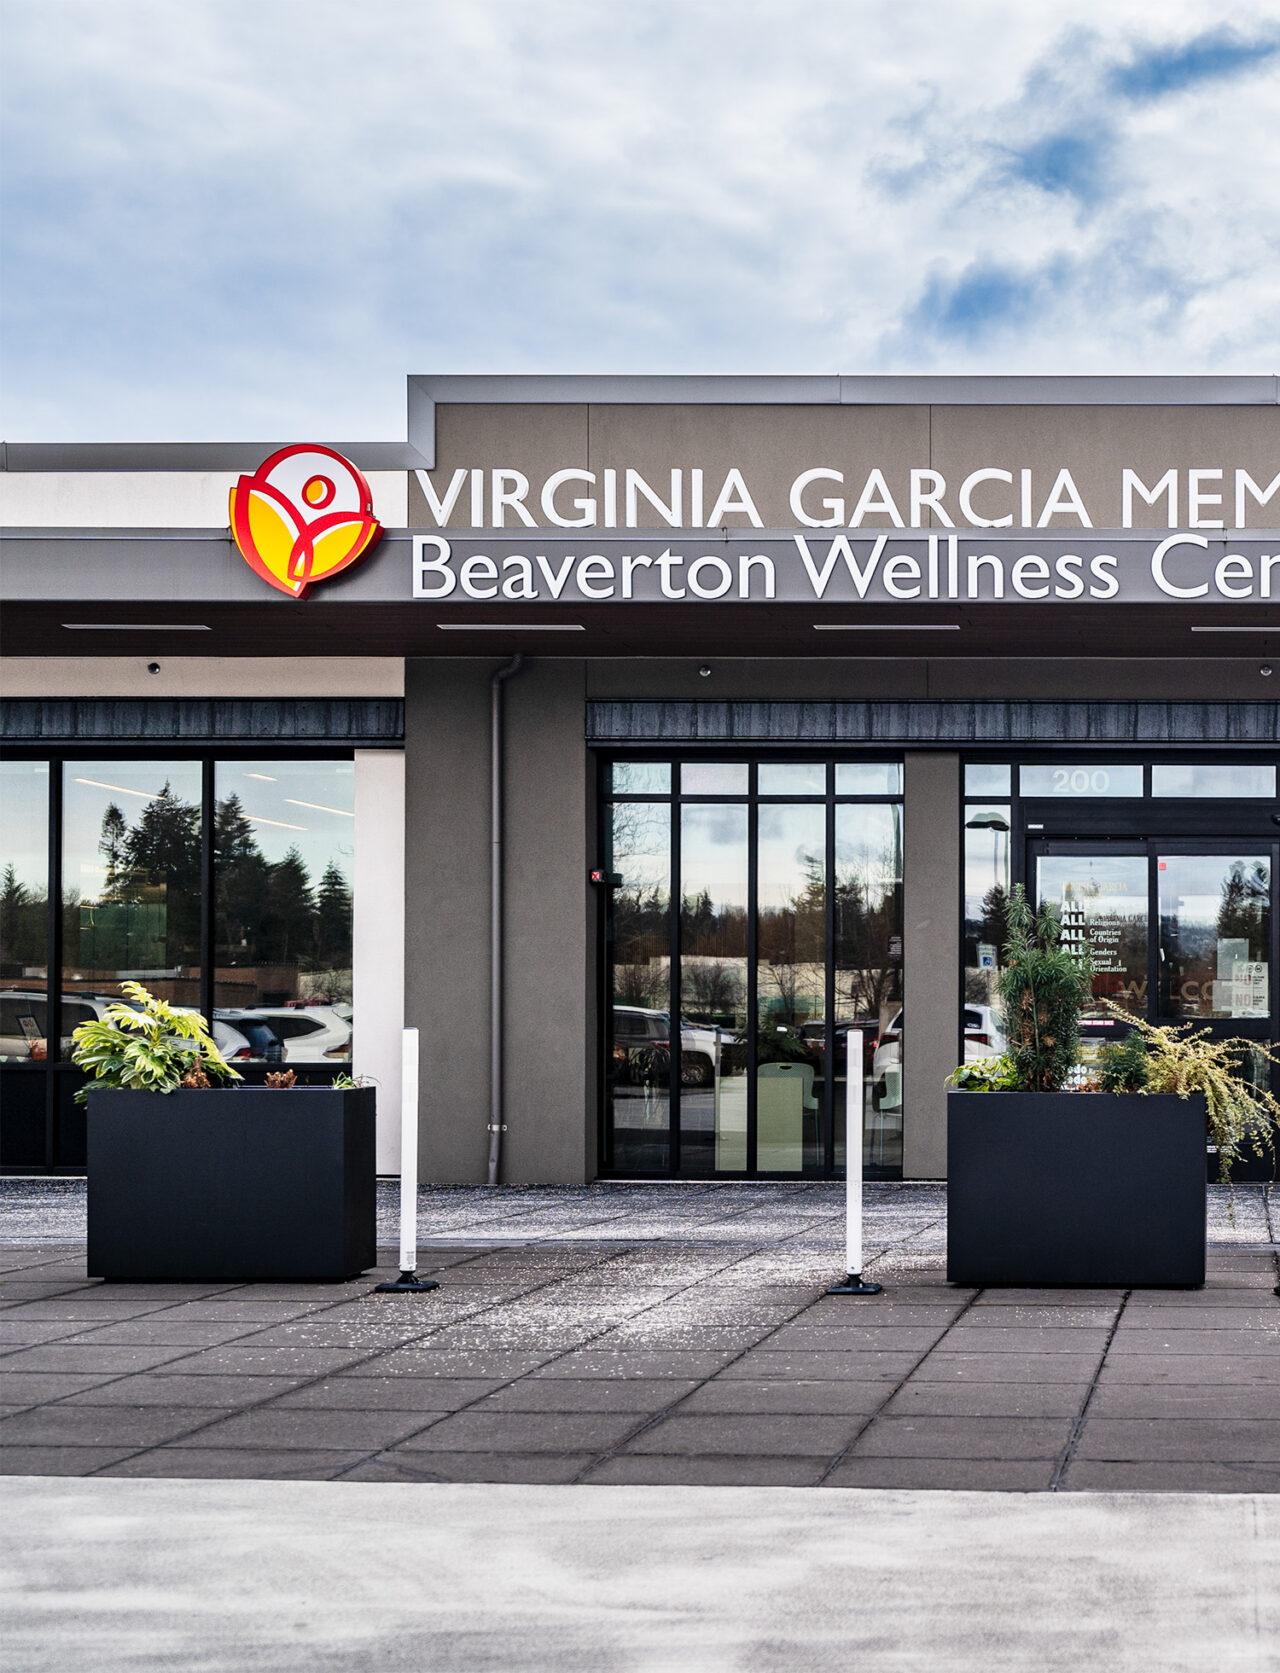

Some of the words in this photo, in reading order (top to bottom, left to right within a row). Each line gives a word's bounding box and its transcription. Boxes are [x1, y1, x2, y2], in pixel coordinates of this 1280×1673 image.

[411, 469, 764, 529] VIRGINIA
[789, 468, 1093, 529] GARCIA
[411, 535, 776, 601] Beaverton
[793, 534, 1119, 601] Wellness
[1052, 769, 1110, 793] 200
[1060, 914, 1085, 926] ALL
[1060, 929, 1085, 941] ALL
[1089, 928, 1121, 936] Countries
[1098, 936, 1119, 944] Origin
[1089, 948, 1117, 956] Genders
[1089, 958, 1112, 966] Sexual
[1089, 965, 1127, 973] Orientation
